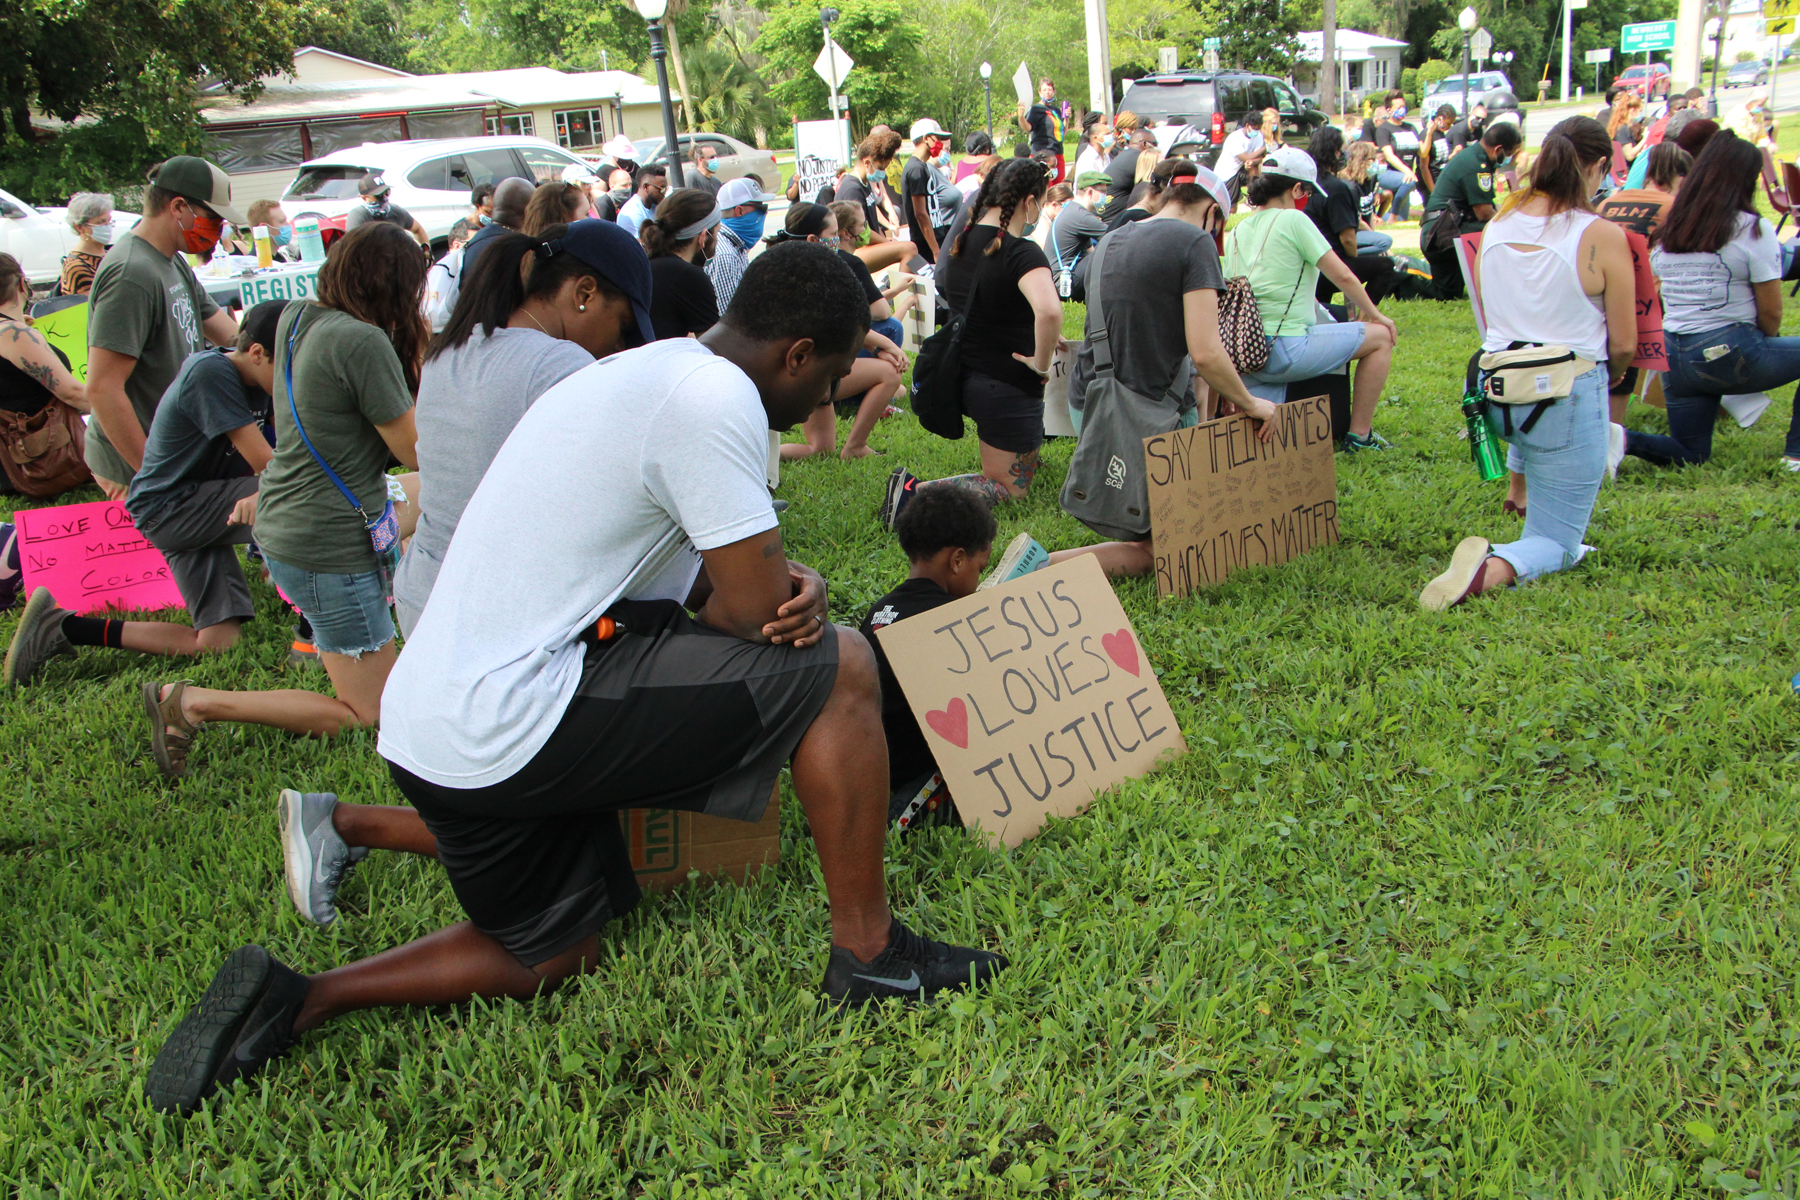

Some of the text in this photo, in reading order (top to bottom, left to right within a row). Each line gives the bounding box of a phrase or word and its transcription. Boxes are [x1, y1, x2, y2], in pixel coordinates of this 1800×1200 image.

[1627, 32, 1670, 43] HIGH SCHOOL
[1631, 25, 1667, 34] NEWBERRY
[798, 158, 839, 178] NO JUSTICE
[800, 175, 836, 194] NO PEACE
[1605, 206, 1650, 218] BLM
[1146, 427, 1195, 486] SAY
[1198, 415, 1267, 474] THEIR
[1270, 397, 1331, 459] NAMES
[1105, 477, 1122, 490] sca
[23, 515, 91, 541] LOVE
[1271, 500, 1340, 562] MATTER
[1016, 545, 1038, 574] NOBULL
[80, 567, 168, 590] COLOR
[934, 579, 1082, 674] JESUS
[966, 636, 1110, 736] LOVES
[973, 687, 1168, 818] JUSTICE
